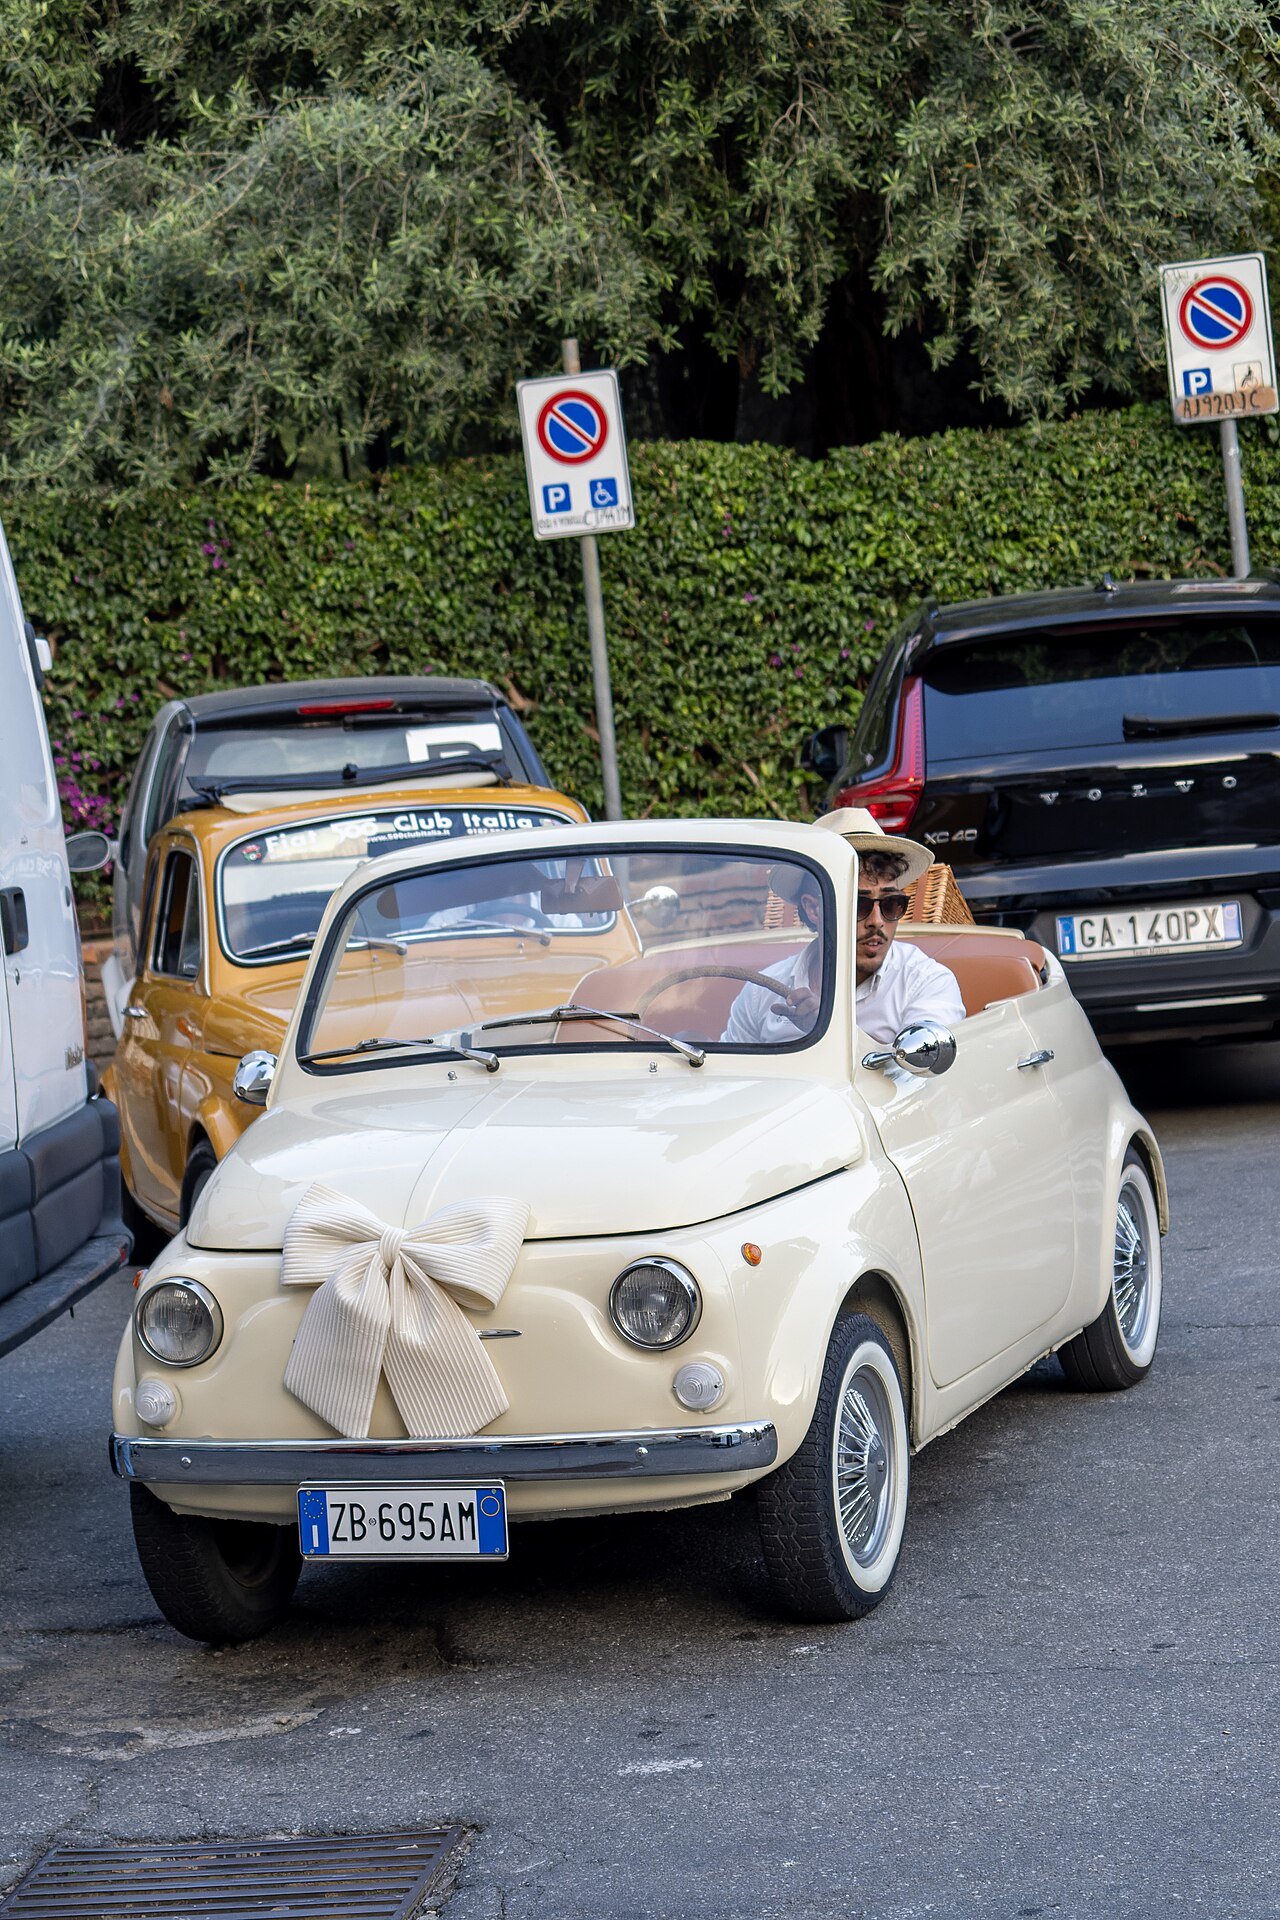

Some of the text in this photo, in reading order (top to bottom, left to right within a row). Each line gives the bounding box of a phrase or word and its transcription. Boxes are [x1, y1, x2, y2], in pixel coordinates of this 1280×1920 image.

[1188, 371, 1208, 396] P
[547, 487, 566, 511] P
[1039, 775, 1237, 806] VOLVO
[264, 811, 534, 857] Fiat 500 Club Italia
[923, 828, 978, 845] XC 40
